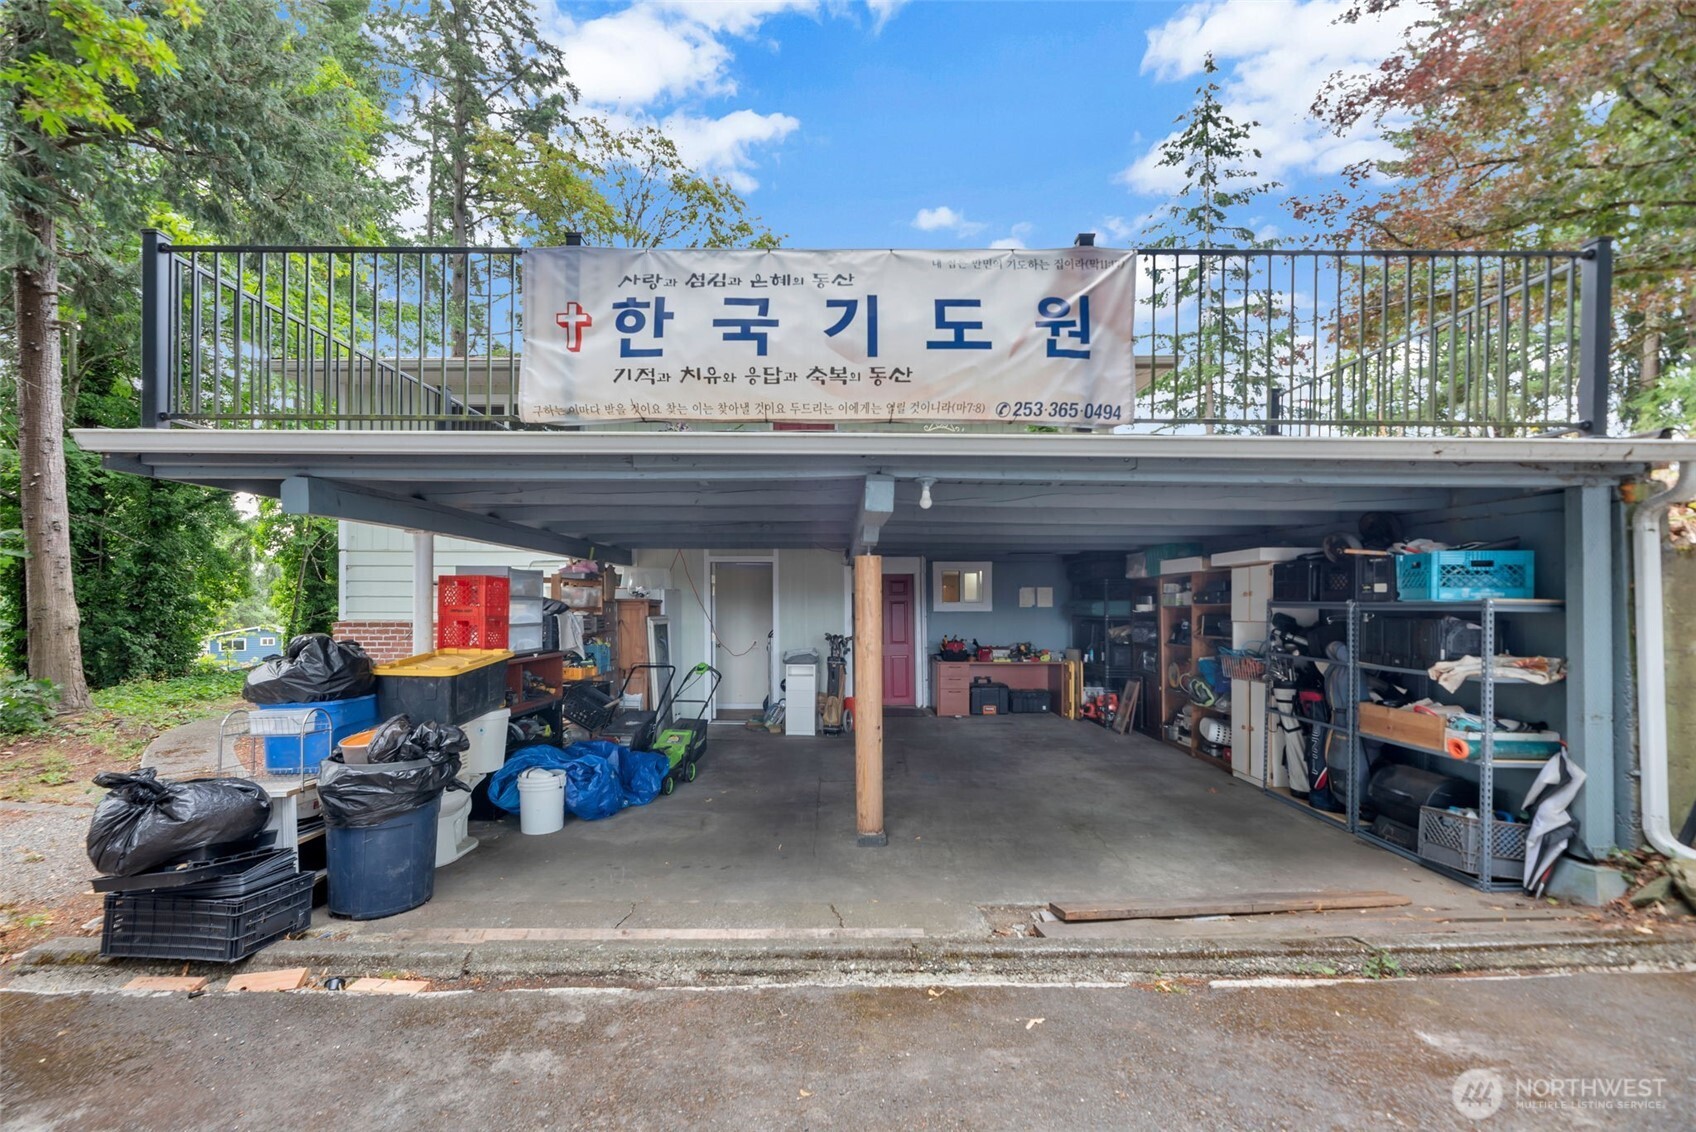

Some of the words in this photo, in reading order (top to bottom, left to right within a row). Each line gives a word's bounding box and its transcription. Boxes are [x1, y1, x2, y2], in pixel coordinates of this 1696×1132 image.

[1007, 258, 1049, 271] 기도하는
[617, 273, 678, 290] 사랑과
[685, 272, 743, 289] 섬김과
[750, 273, 805, 289] 은혜의
[811, 272, 855, 289] 동산
[612, 366, 671, 385] 기적과
[679, 366, 737, 385] 치유와
[744, 366, 798, 386] 응답과
[805, 366, 861, 386] 축복의
[868, 366, 913, 386] 동산
[532, 404, 565, 416] 구하는
[568, 403, 601, 416] 이마다
[604, 403, 627, 416] 받을
[666, 401, 688, 416] 찾는
[692, 401, 714, 415] 이는
[717, 401, 751, 416] 찾아낼
[754, 401, 786, 416] 것이요
[789, 401, 834, 415] 두드리는
[838, 401, 882, 415] 이에게는
[909, 401, 986, 415] 것이니라(마7:8)
